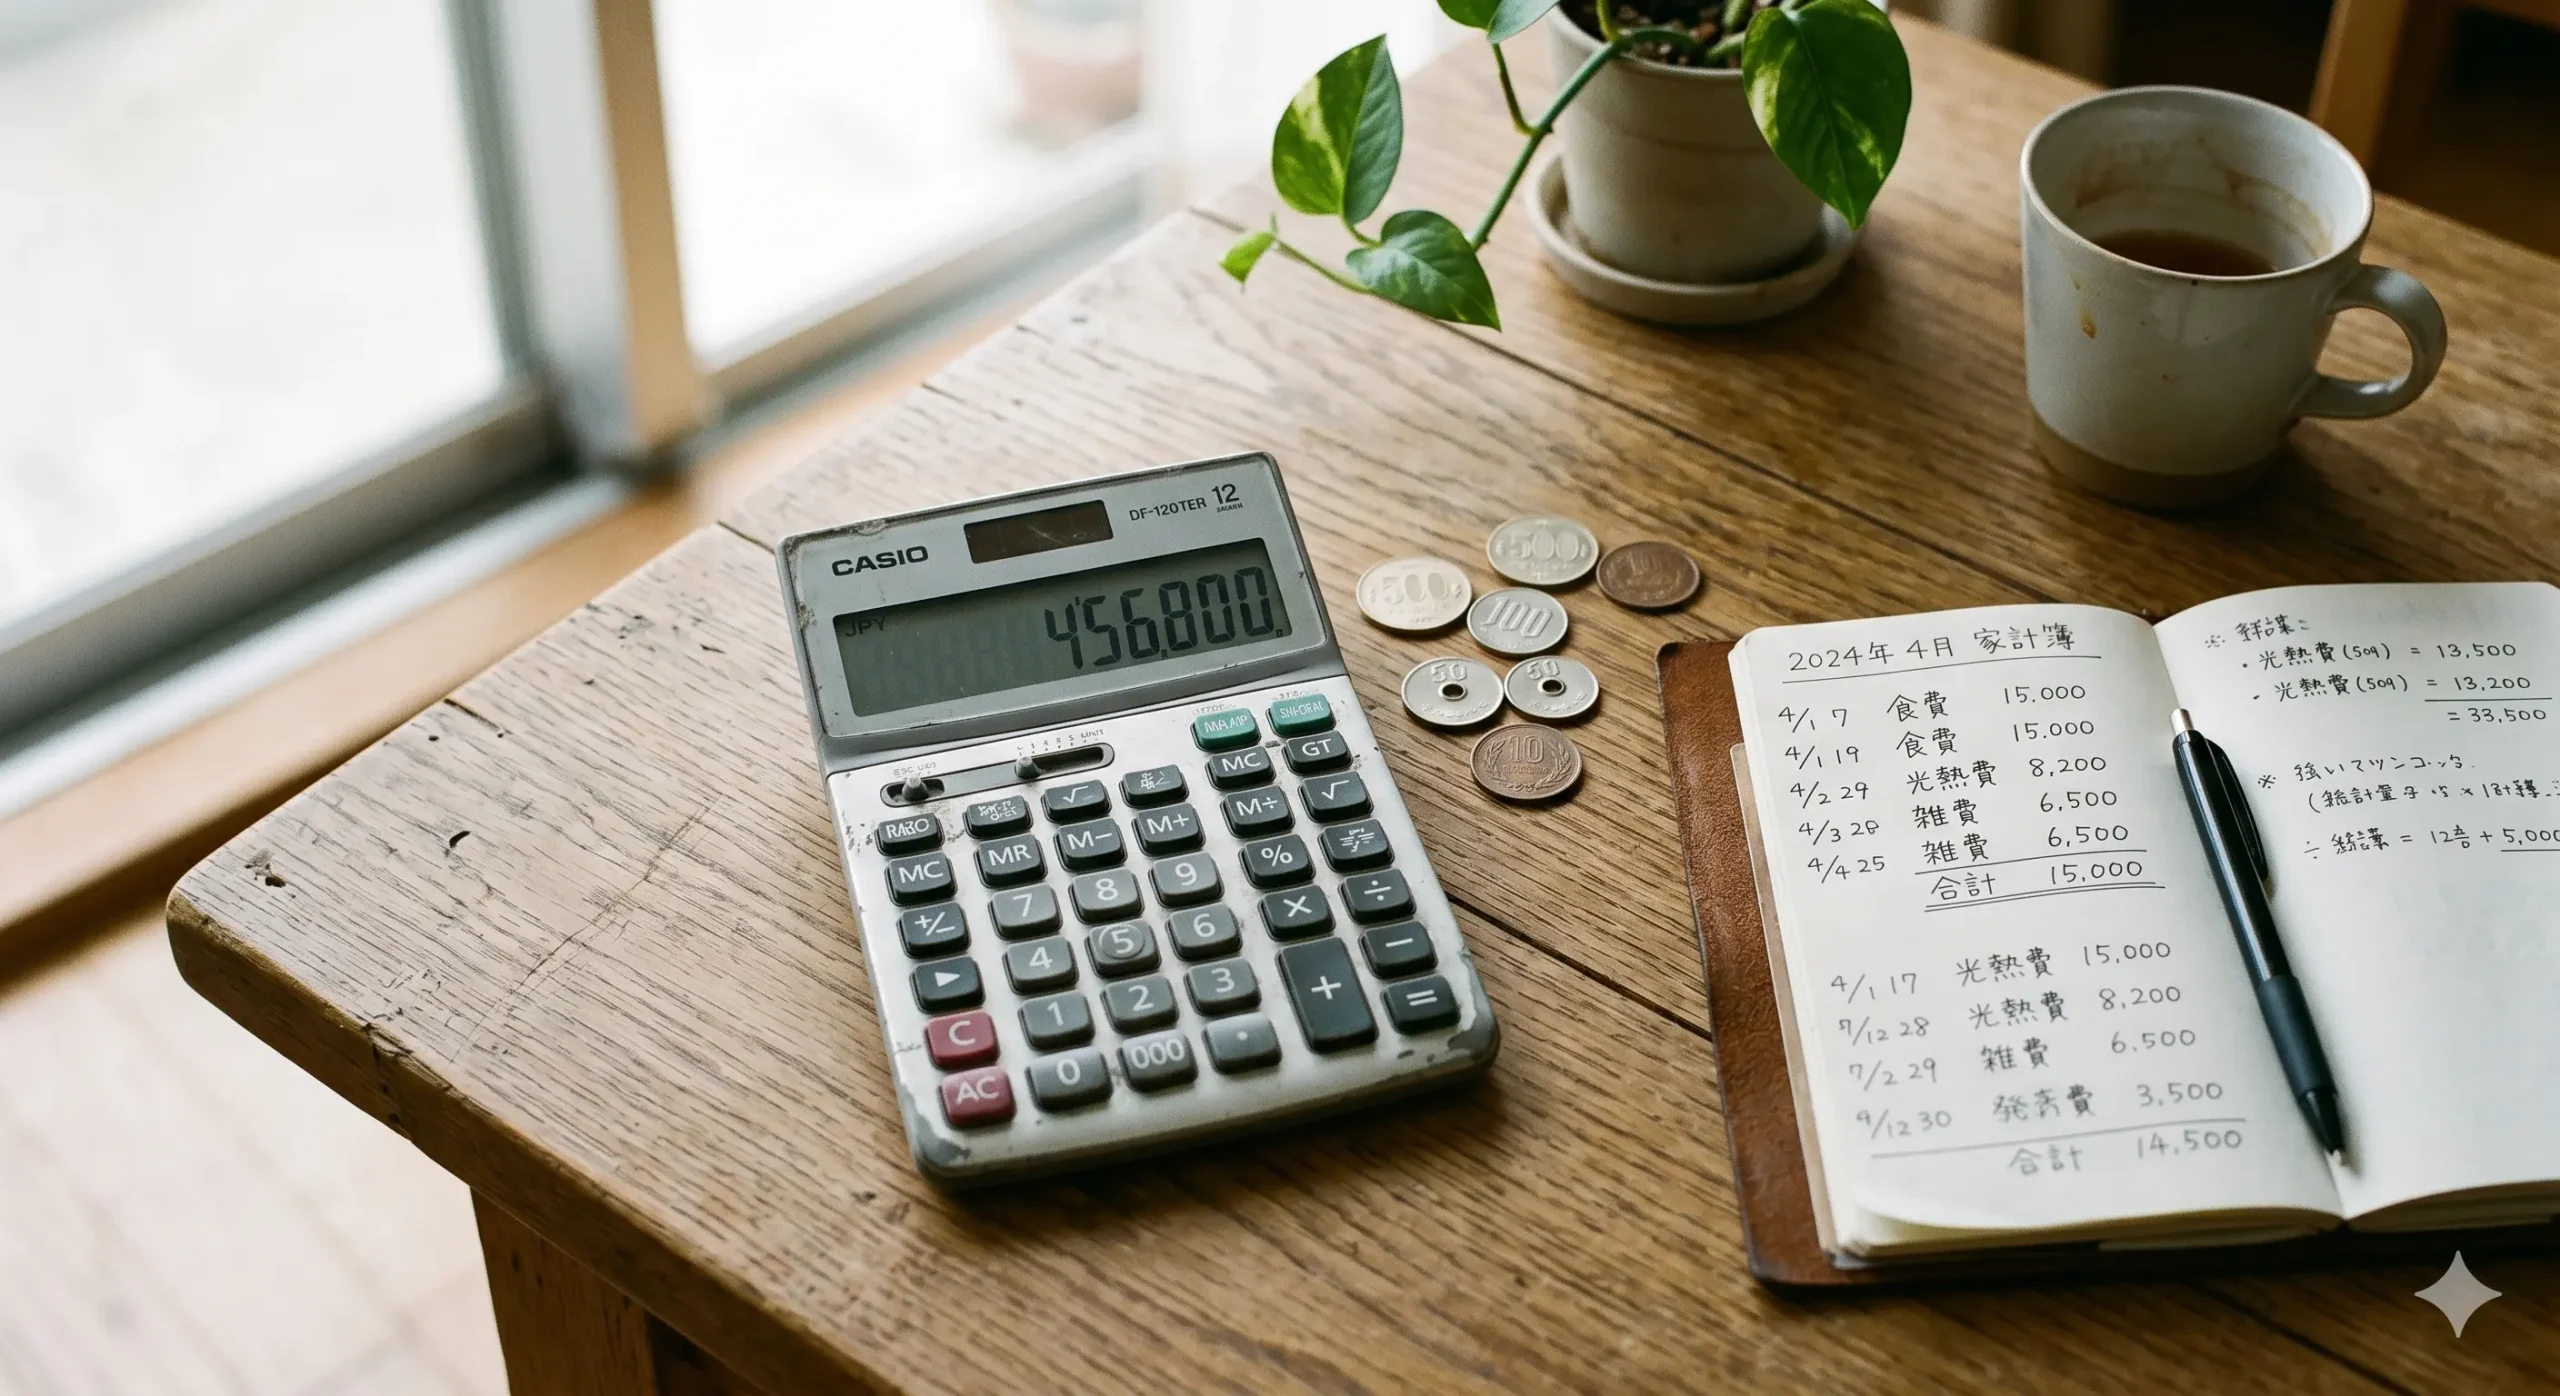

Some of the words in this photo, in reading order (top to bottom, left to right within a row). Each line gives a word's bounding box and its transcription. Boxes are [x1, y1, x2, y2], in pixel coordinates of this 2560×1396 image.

[1128, 497, 1207, 521] DF-120TER
[1211, 483, 1240, 505] 12
[831, 545, 929, 577] CASIO
[1511, 528, 1581, 561] 500
[1380, 572, 1449, 605] 500
[844, 615, 887, 638] JPY
[1481, 595, 1554, 639] 100
[1788, 641, 1895, 671] 2024年
[1906, 636, 1954, 660] 4月
[1974, 623, 2076, 654] 家計簿
[1430, 662, 1468, 684] 50
[1526, 660, 1561, 681] 50
[1778, 706, 1816, 733] 4/1
[1832, 708, 1848, 727] 7
[1886, 690, 1949, 720] 食費
[1221, 753, 1261, 772] MC
[1301, 738, 1332, 757] GT
[1508, 736, 1545, 764] 10
[1785, 745, 1823, 770] 4/1
[1836, 745, 1860, 764] 19
[1896, 727, 1958, 759] 食費
[1790, 781, 1832, 809] 4/2
[1840, 781, 1869, 800] 29
[1906, 760, 1997, 795] 光熱費
[1798, 820, 1842, 845] 4/3
[1911, 798, 1979, 829] 雑費
[898, 860, 943, 885] MC
[988, 844, 1032, 867] MR
[1146, 813, 1190, 834] M+
[1807, 856, 1851, 884] 4/4
[1858, 856, 1885, 874] 25
[1921, 833, 1989, 865] 雑費
[1012, 893, 1033, 918] 7
[1095, 878, 1119, 902] 8
[1175, 862, 1197, 886] 9
[1261, 846, 1293, 866] %
[1931, 872, 1996, 901] 合計
[1029, 946, 1053, 970] 4
[1110, 928, 1134, 954] 5
[1193, 912, 1217, 938] 6
[1047, 1001, 1065, 1026] 1
[1127, 984, 1154, 1011] 2
[1211, 967, 1235, 993] 3
[1831, 974, 1876, 1004] 4/1
[1890, 973, 1916, 994] 17
[1956, 948, 2052, 986] 光熱費
[949, 1020, 976, 1046] C
[1899, 1017, 1930, 1037] 28
[1969, 991, 2068, 1029] 光熱費
[955, 1076, 1000, 1104] AC
[1056, 1058, 1081, 1085] 0
[1130, 1038, 1185, 1070] 000
[1908, 1057, 1937, 1083] 29
[1981, 1037, 2050, 1073] 雑費
[1918, 1110, 1952, 1132] 30
[2009, 1143, 2083, 1176] 合計
